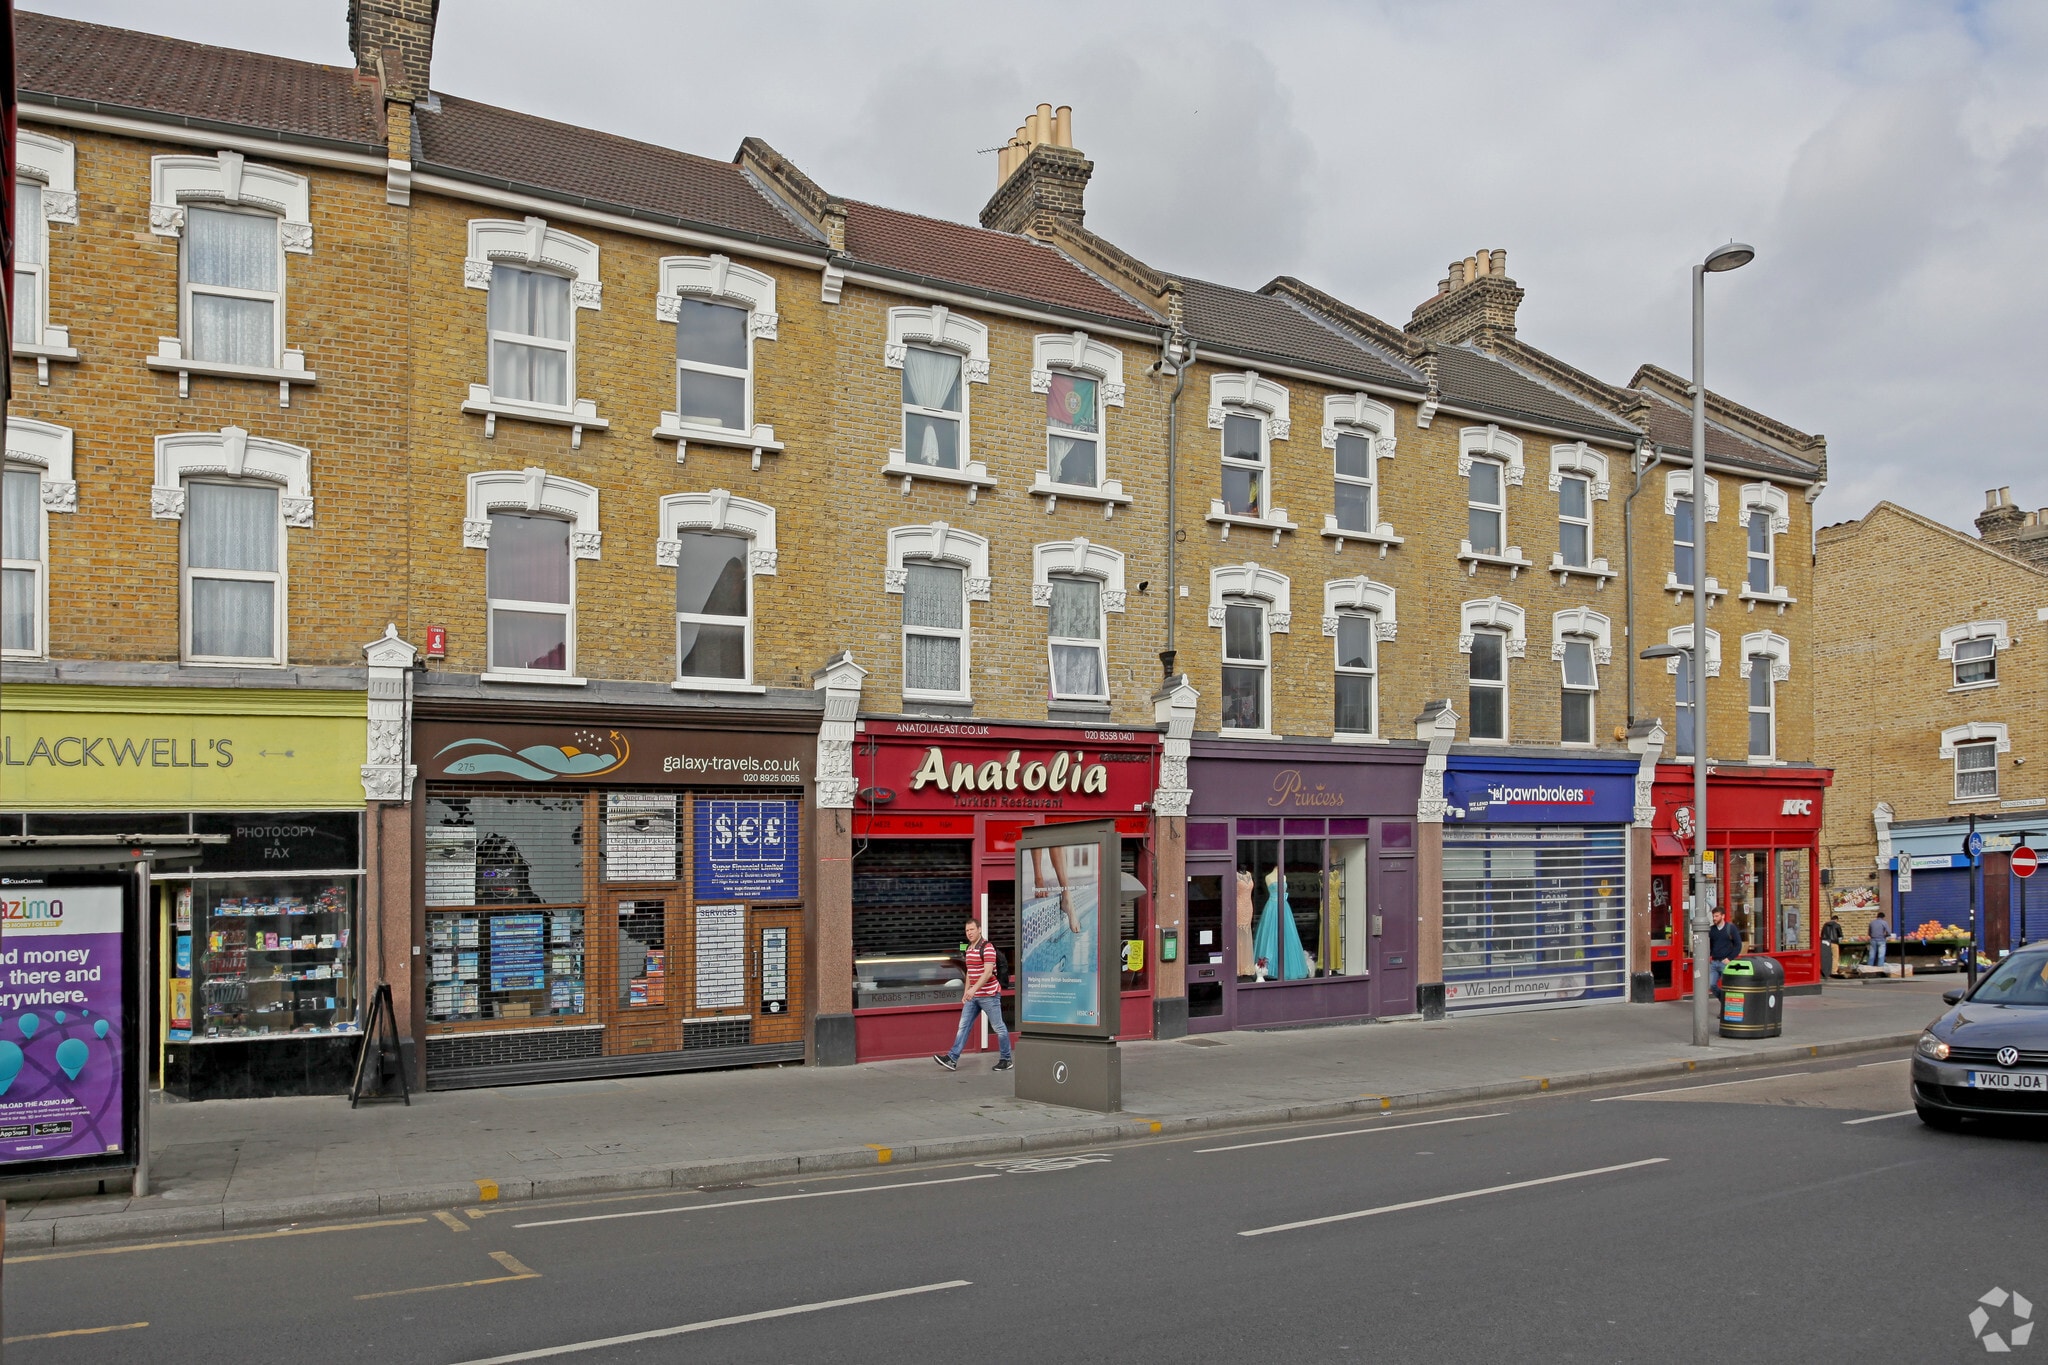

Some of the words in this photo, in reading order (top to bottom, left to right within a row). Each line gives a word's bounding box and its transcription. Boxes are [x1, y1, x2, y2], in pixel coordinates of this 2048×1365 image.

[896, 723, 989, 735] ANATOLIAEAST.CO.UK
[1084, 731, 1098, 740] 020
[1100, 731, 1118, 740] 8558
[1120, 732, 1135, 740] 0401
[0, 736, 234, 767] LACKWELL'S
[457, 763, 475, 772] 275
[663, 755, 800, 773] galaxy-travels.co.uk
[910, 746, 1107, 793] Anatolia
[760, 774, 779, 782] 8925
[781, 774, 800, 782] 0055
[1268, 770, 1344, 806] Princess
[1504, 785, 1584, 803] pawnbrokers
[954, 795, 996, 808] Turkish
[1000, 796, 1062, 808] Restaurant
[1781, 799, 1812, 816] KFC
[236, 826, 316, 838] PHOTOCOPY
[264, 848, 290, 858] FAX
[712, 864, 732, 872] Super
[1542, 894, 1568, 904] LOANS
[24, 949, 90, 965] money
[9, 970, 60, 984] there
[65, 966, 100, 982] and
[1465, 983, 1484, 996] We
[1489, 980, 1510, 994] lend
[1515, 982, 1550, 996] money
[0, 989, 88, 1010] rywhere.
[872, 993, 902, 1002] Kebabs
[910, 992, 926, 1000] Fish
[934, 991, 957, 1000] Stews
[1980, 1074, 2010, 1086] VK10
[2014, 1075, 2041, 1088] JOA
